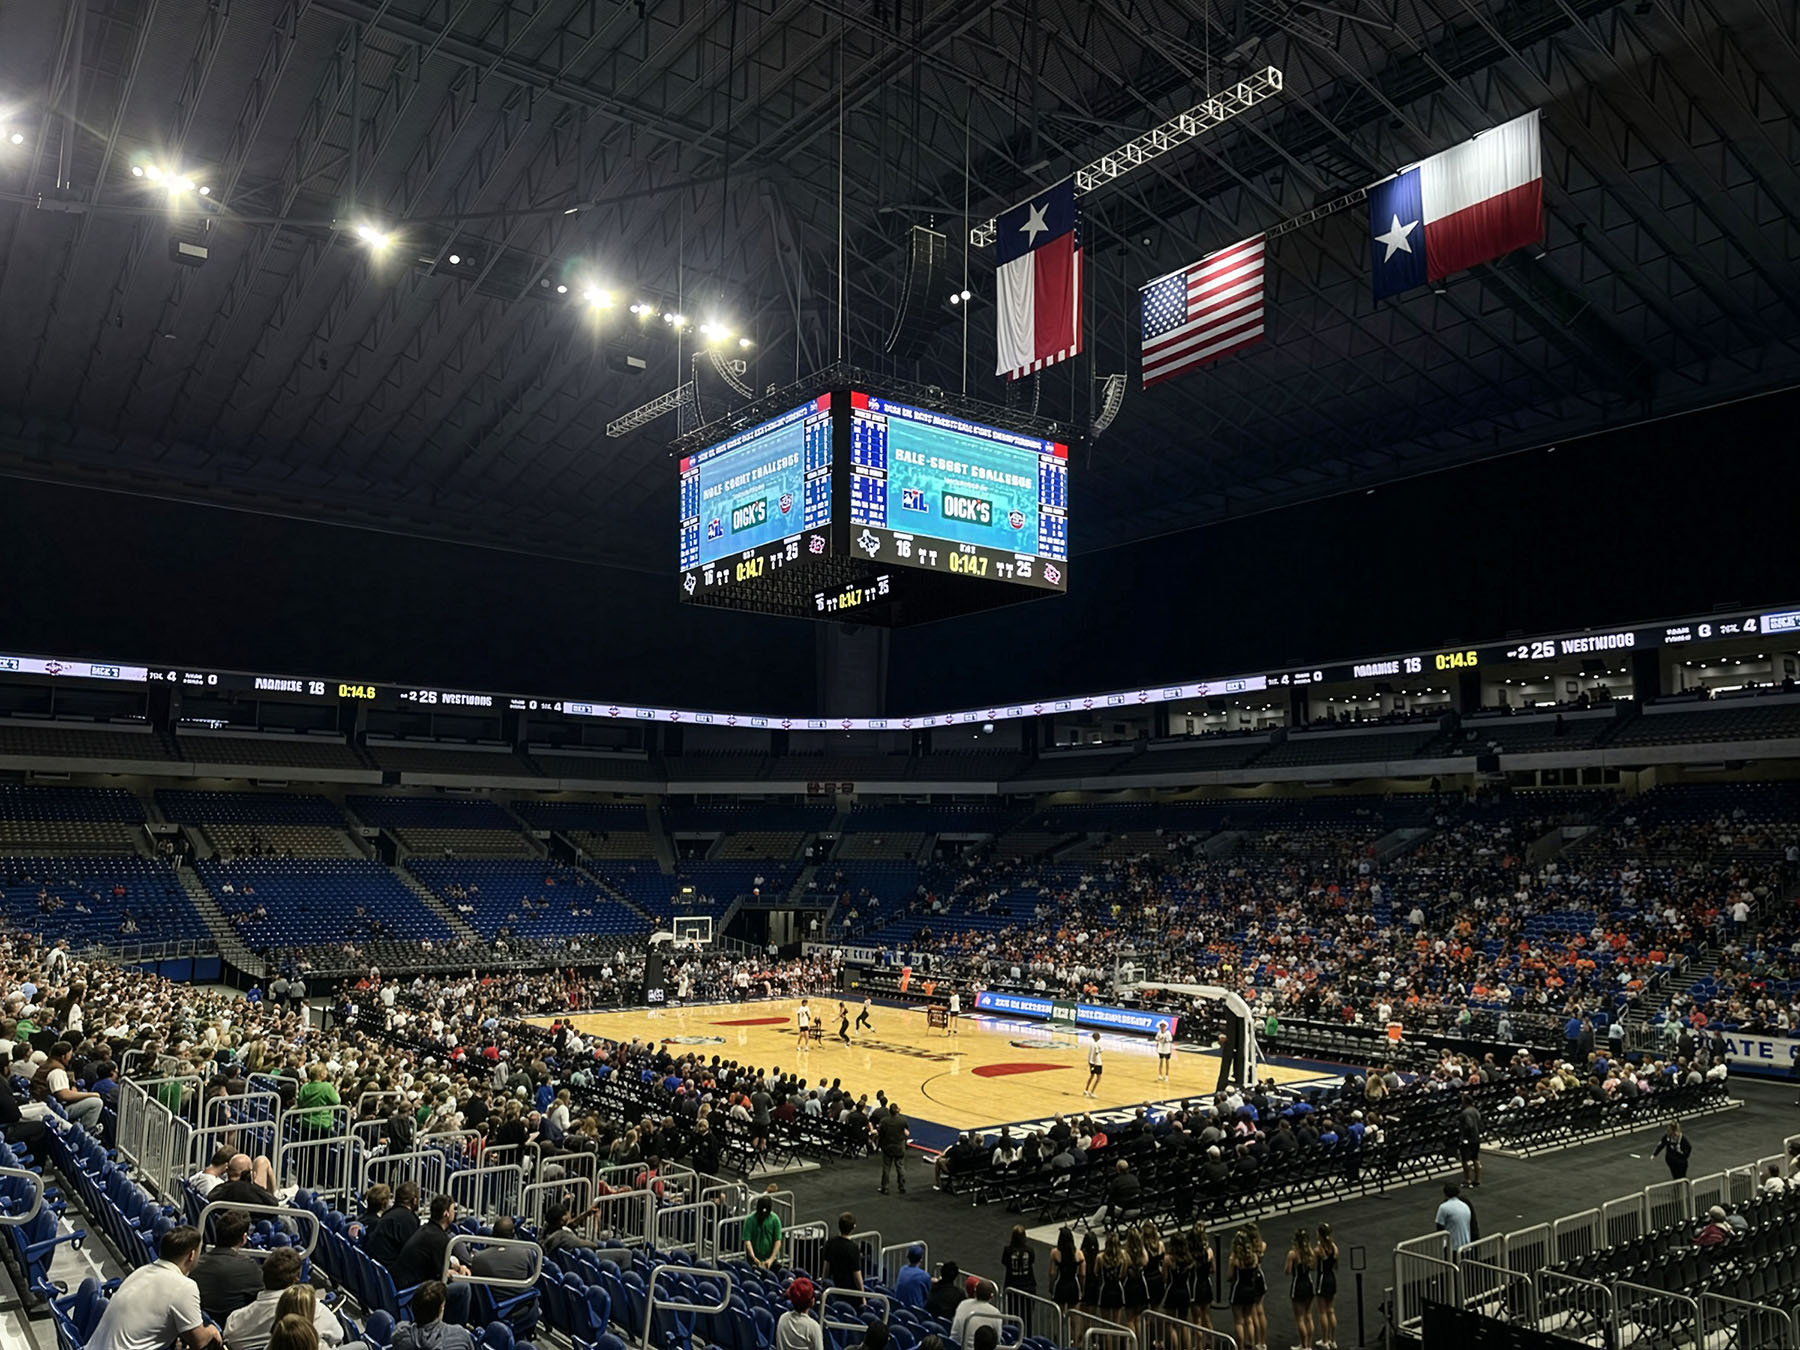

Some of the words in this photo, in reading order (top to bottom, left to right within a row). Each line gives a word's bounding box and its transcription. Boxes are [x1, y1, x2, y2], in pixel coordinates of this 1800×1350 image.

[733, 501, 766, 530] DICK'S
[944, 495, 990, 523] DICK'S
[786, 542, 799, 561] 25
[896, 540, 911, 558] 16
[736, 556, 764, 581] 0:14.7
[949, 551, 988, 576] 0:14.7
[1016, 560, 1032, 578] 25
[1531, 640, 1556, 660] 25
[1403, 657, 1422, 673] 16
[1435, 651, 1478, 670] 0:14.6
[338, 684, 376, 699] 0:14.6
[419, 690, 437, 704] 25
